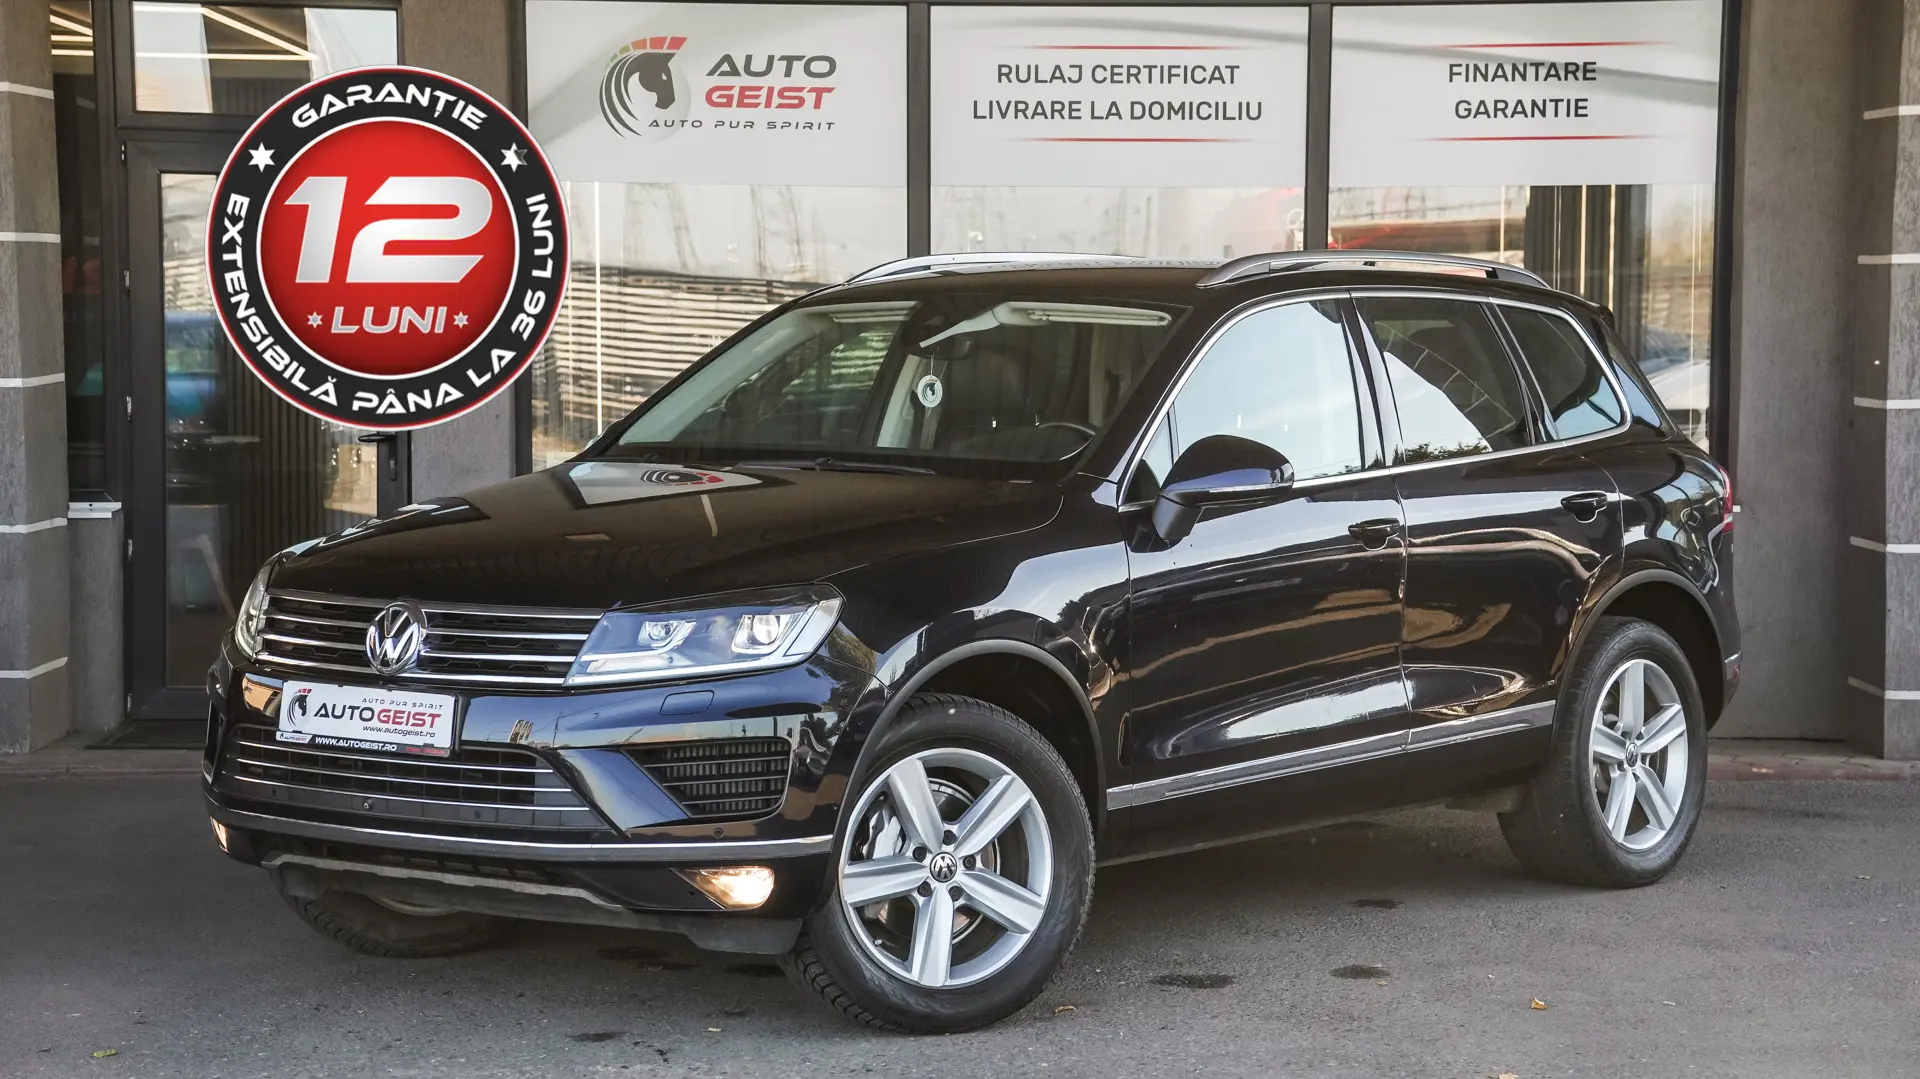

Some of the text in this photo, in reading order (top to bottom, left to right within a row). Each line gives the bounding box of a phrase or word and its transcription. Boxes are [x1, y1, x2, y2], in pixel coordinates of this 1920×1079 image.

[706, 53, 837, 78] AUTO
[997, 64, 1240, 84] RULAJ CERTIFICAT
[1448, 61, 1597, 83] FINANTARE
[705, 85, 837, 109] GEIST
[973, 100, 1262, 121] LIVRARE LA DOMICILIU
[1455, 98, 1589, 119] GARANTIE
[648, 119, 836, 131] AUTO PUR SPIRIT
[361, 697, 444, 710] AUTO PUR SPIRIT
[362, 725, 436, 738] www.autogeist.ro
[315, 736, 397, 752] WWW.AUTOGEIST.RO
